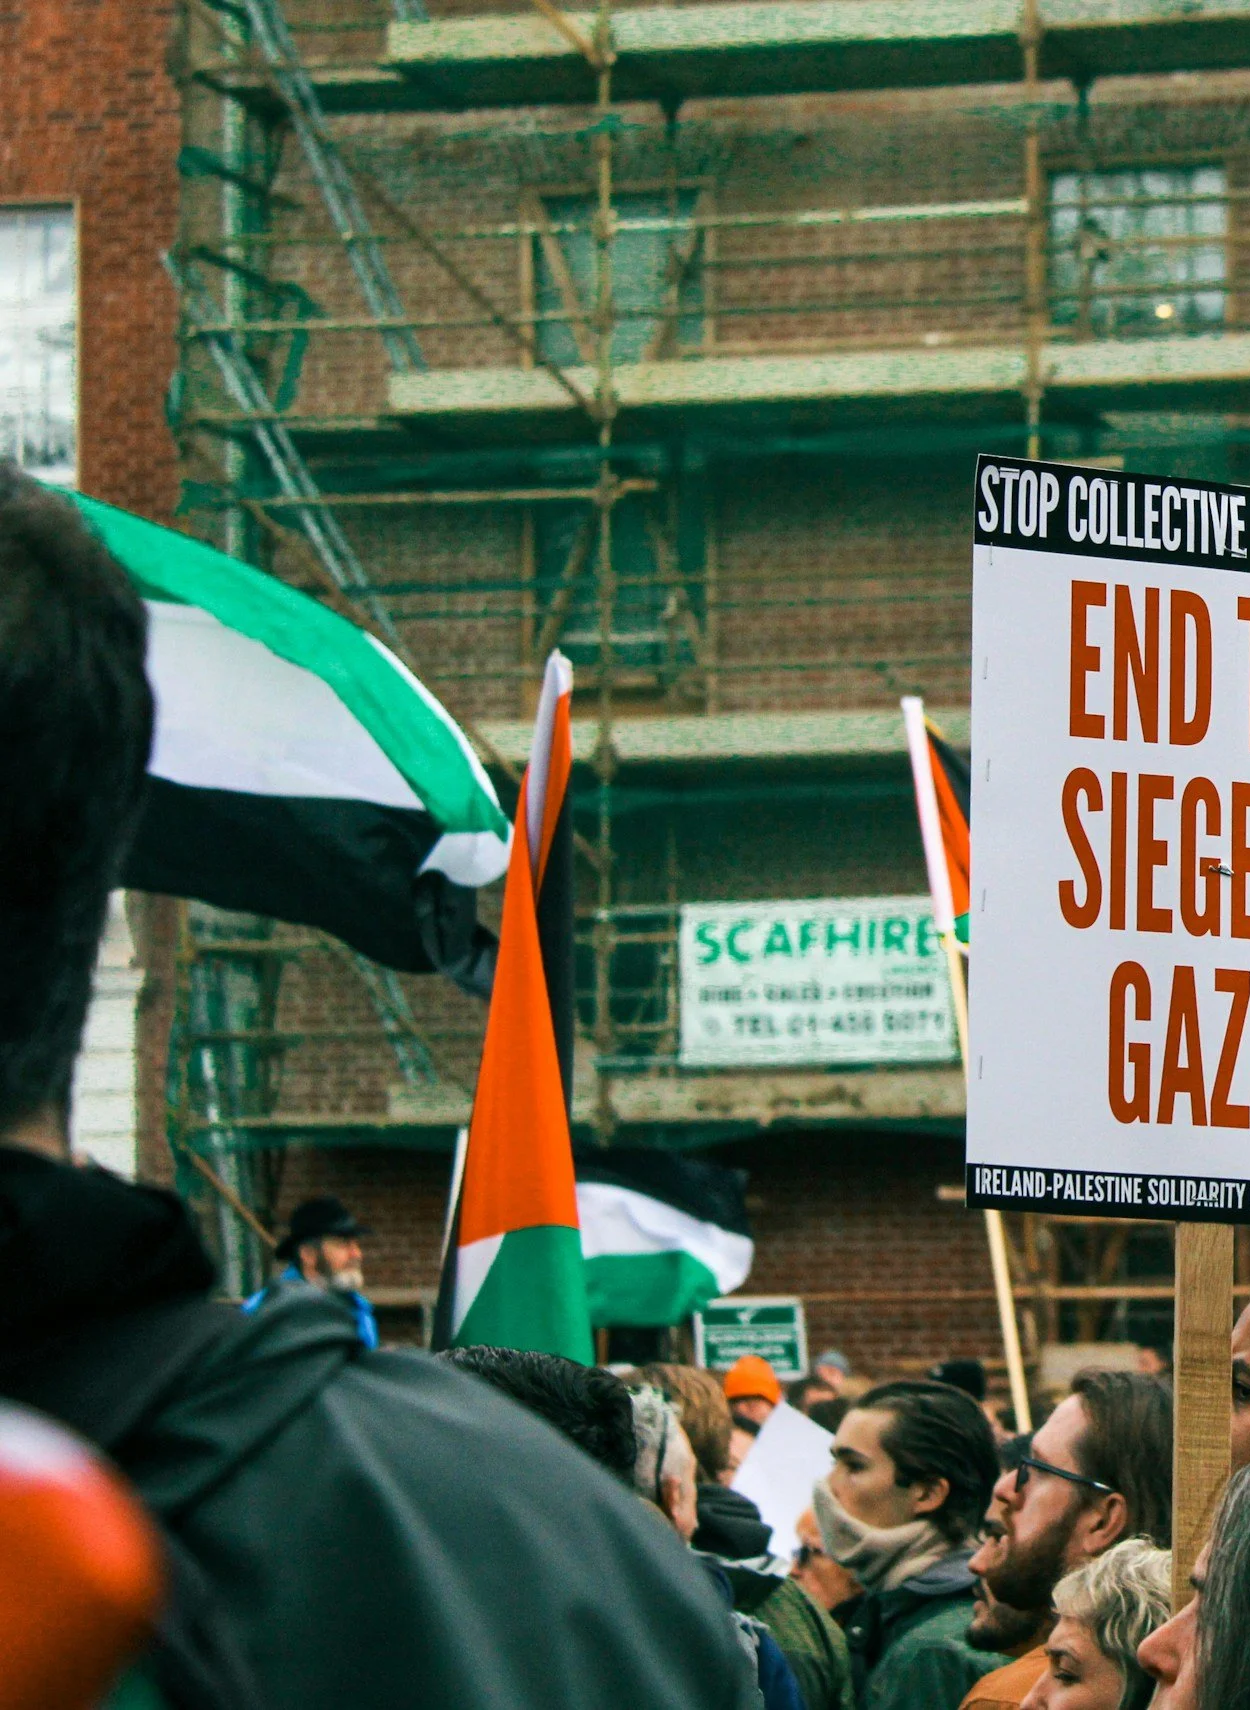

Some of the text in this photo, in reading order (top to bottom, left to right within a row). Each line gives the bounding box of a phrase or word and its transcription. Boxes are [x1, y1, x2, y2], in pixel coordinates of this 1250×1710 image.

[978, 465, 1060, 538] STOP
[1068, 475, 1247, 559] COLLECTIVE
[1069, 580, 1212, 746] END
[695, 917, 940, 965] SCAFHIRE
[975, 1167, 1142, 1204] IRELAND-PALESTINE
[1147, 1178, 1246, 1210] SOLIDARITY
